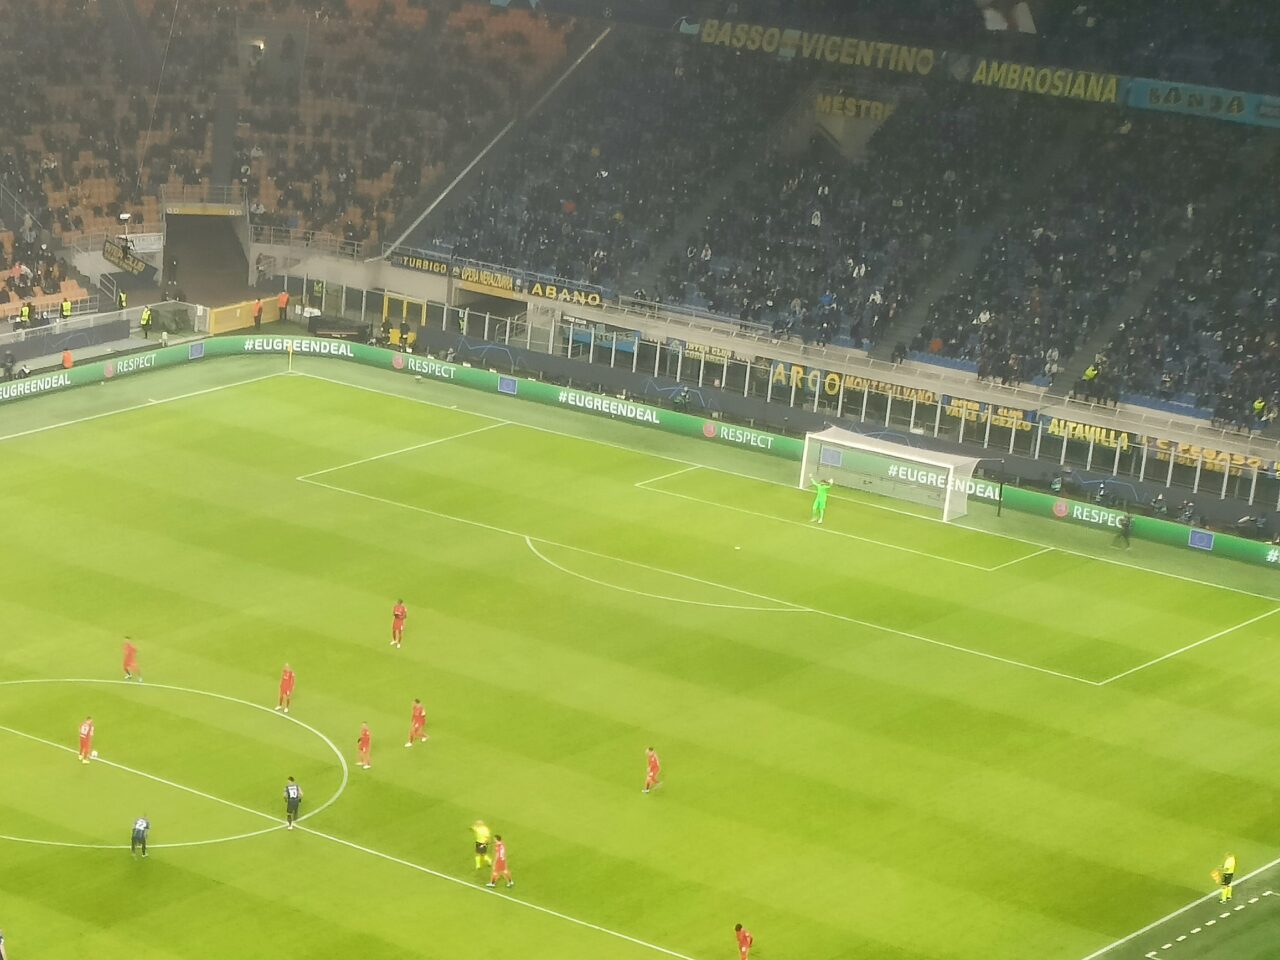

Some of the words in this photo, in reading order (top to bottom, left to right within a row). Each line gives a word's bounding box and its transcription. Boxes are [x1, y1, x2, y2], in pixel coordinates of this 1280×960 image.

[701, 19, 781, 53] BASSO
[800, 32, 937, 75] VICENTINO
[972, 59, 1119, 104] AMBROSIANA
[402, 256, 447, 274] TURBIGO
[531, 281, 600, 306] ABANO
[244, 338, 355, 358] #EUGREENDEAL
[117, 353, 157, 374] RESPECT
[407, 357, 457, 380] RESPECT
[772, 362, 841, 396] ARCO
[558, 391, 660, 424] #EUGREENDEAL
[719, 425, 775, 450] RESPECT
[1047, 417, 1129, 451] ALTAVILLA
[1073, 505, 1126, 529] RESPEC
